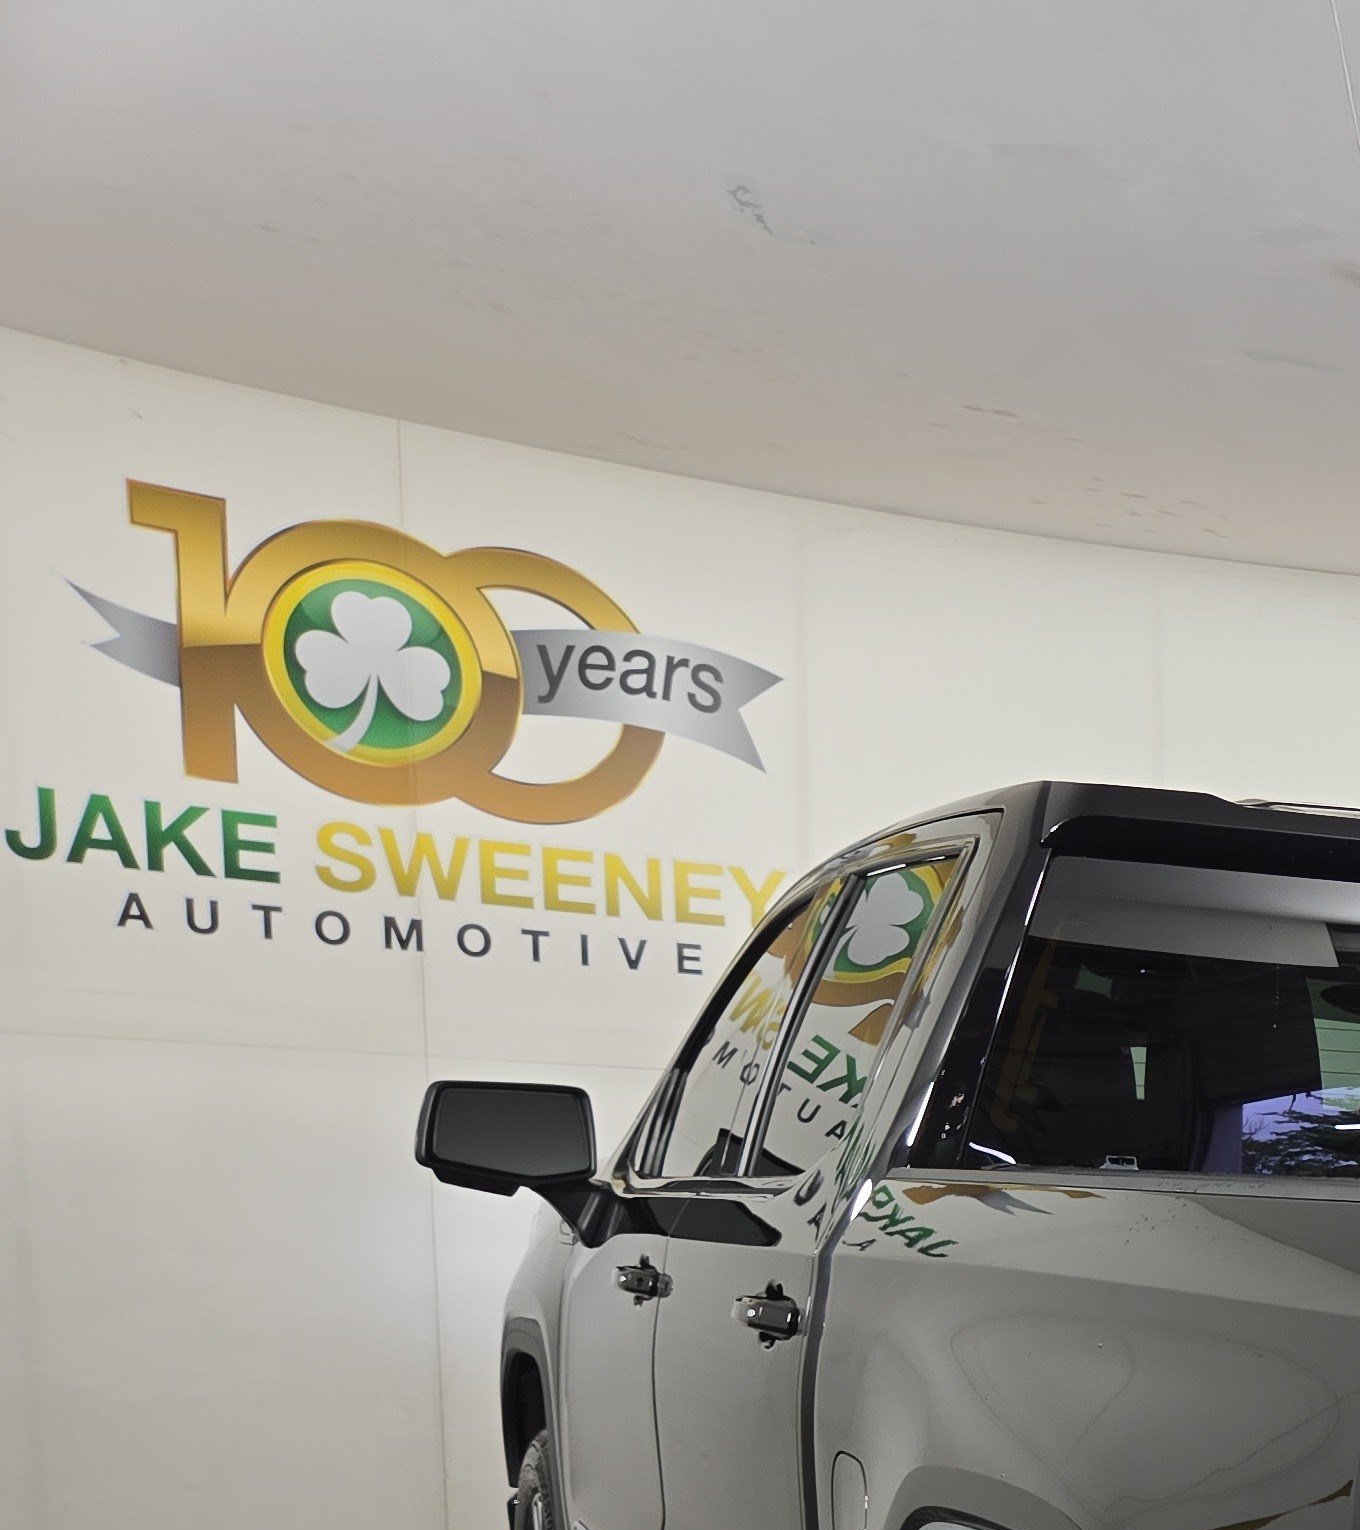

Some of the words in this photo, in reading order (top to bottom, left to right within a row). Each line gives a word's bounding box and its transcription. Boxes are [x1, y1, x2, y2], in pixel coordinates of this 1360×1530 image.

[125, 477, 666, 825] 100
[535, 637, 725, 715] years
[4, 786, 282, 885] JAKE
[314, 820, 788, 929] SWEENEY
[117, 892, 704, 977] AUTOMOTIVE
